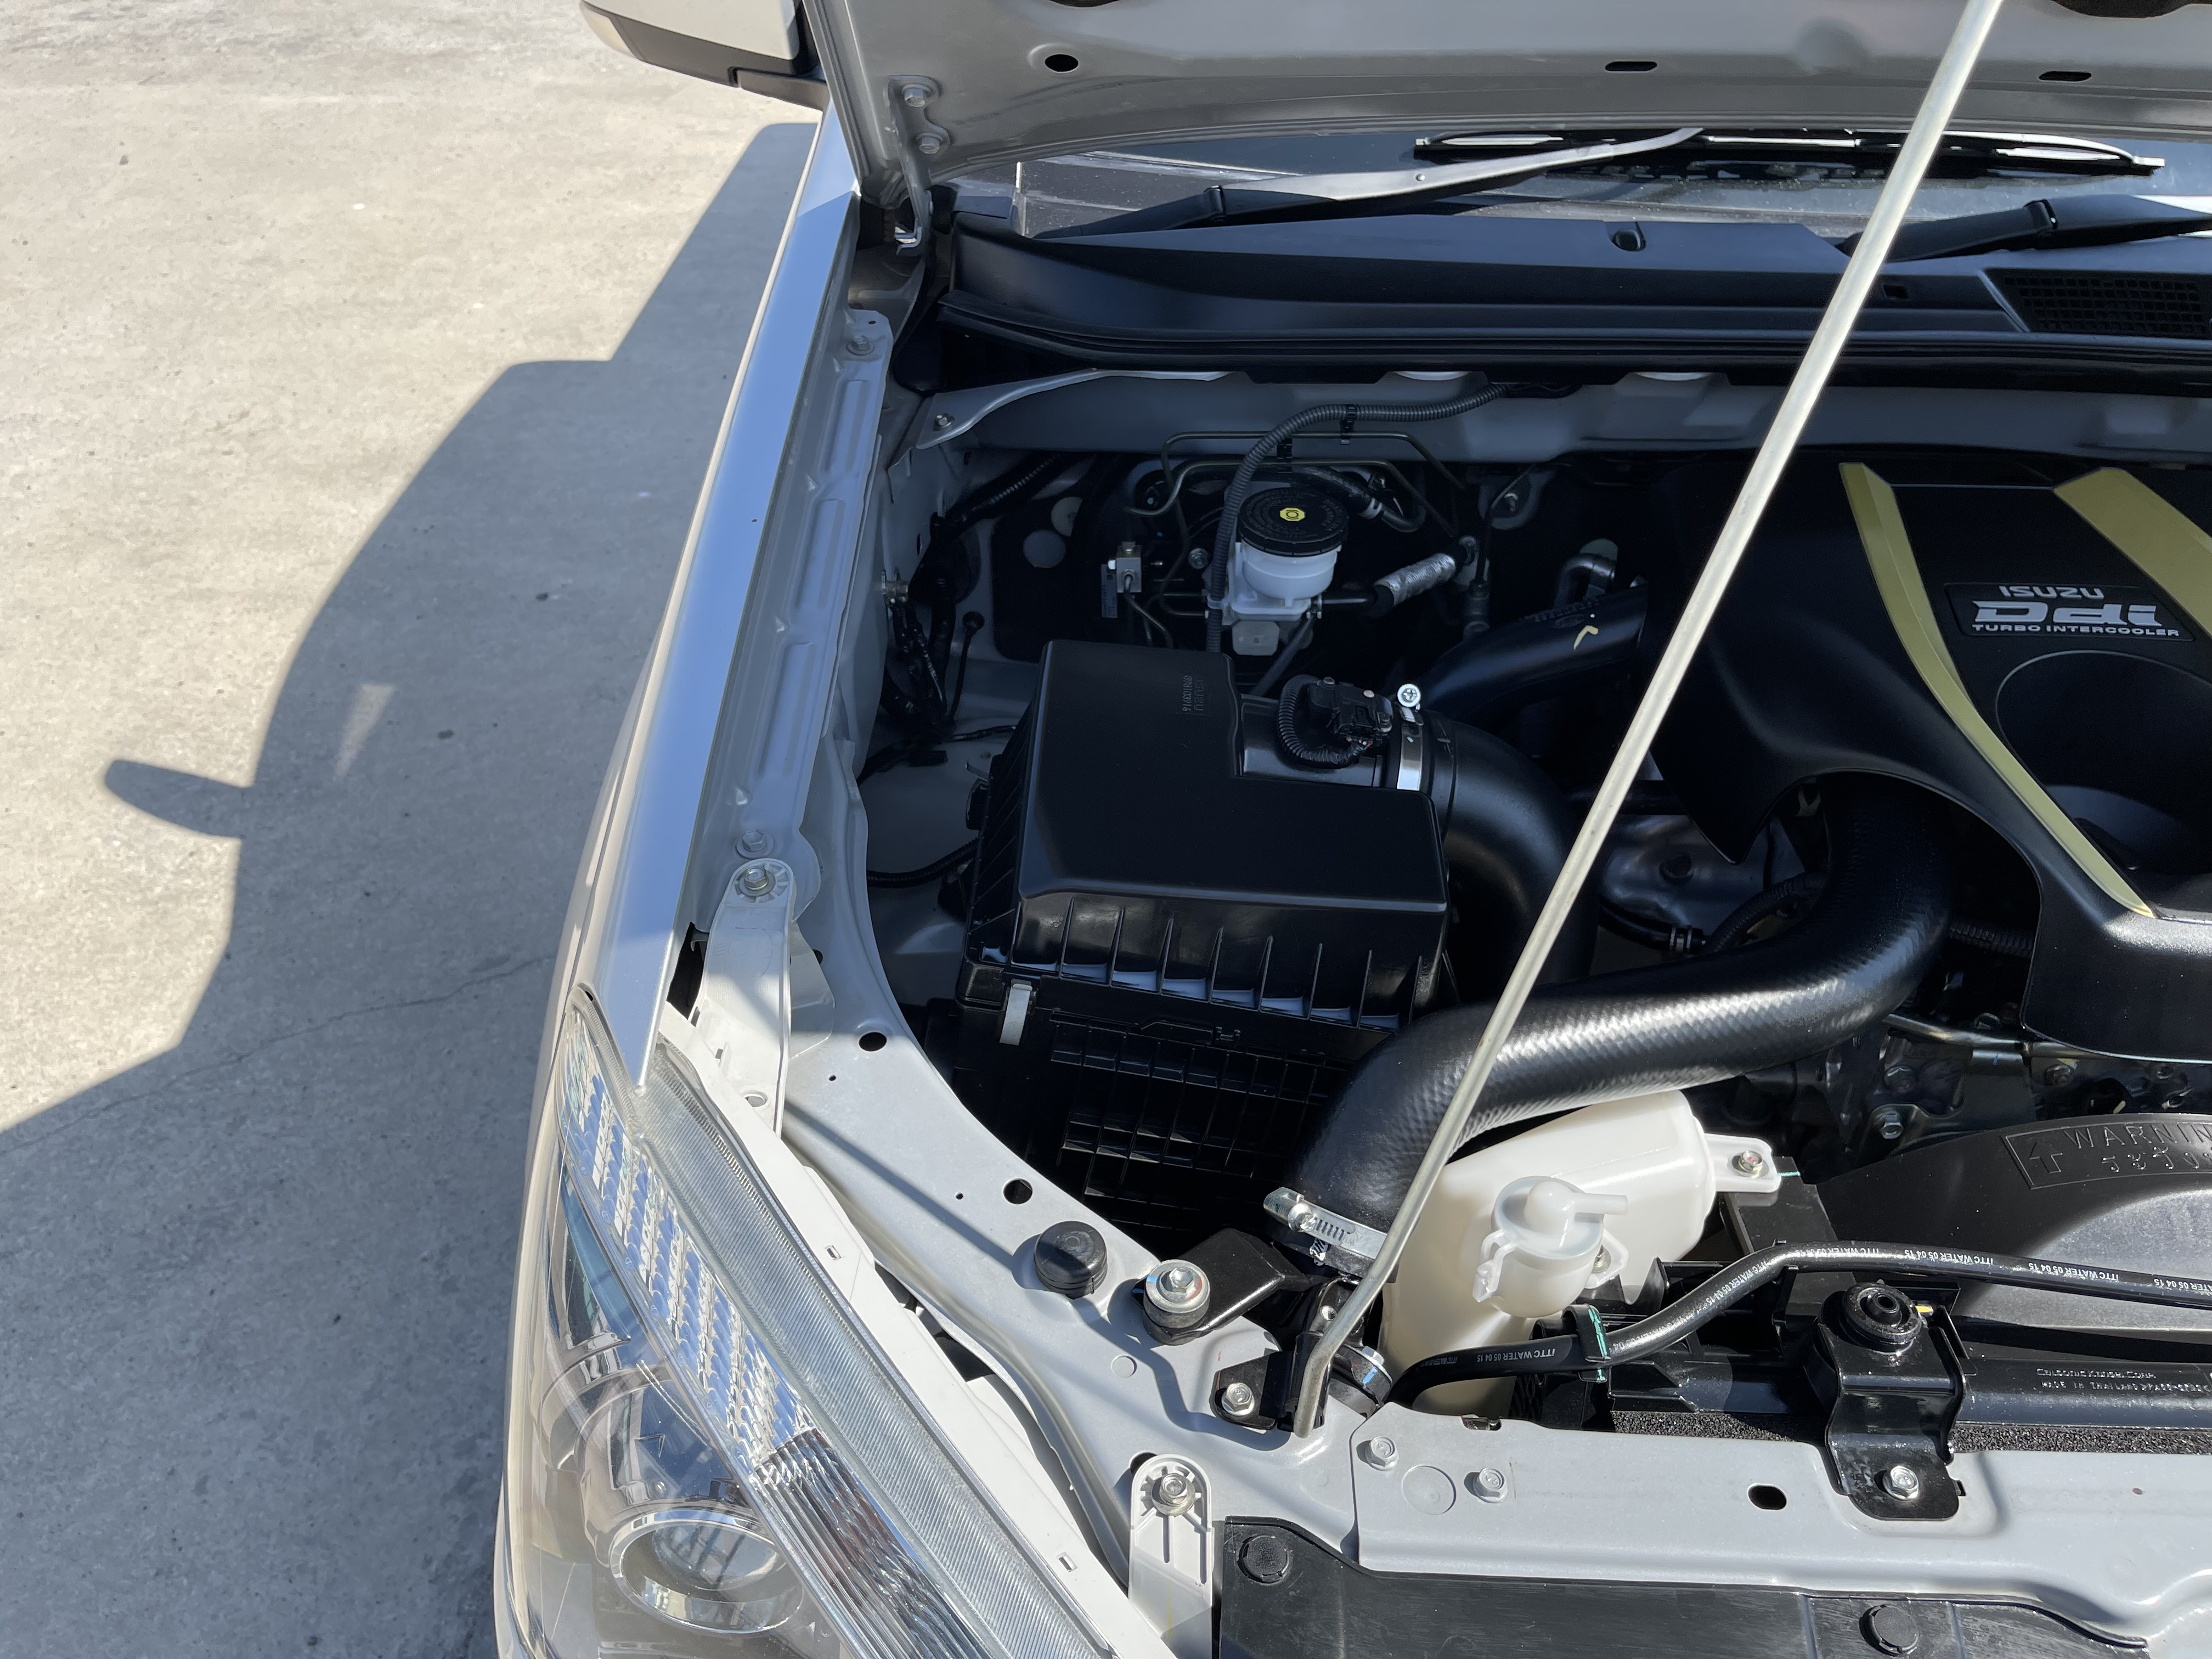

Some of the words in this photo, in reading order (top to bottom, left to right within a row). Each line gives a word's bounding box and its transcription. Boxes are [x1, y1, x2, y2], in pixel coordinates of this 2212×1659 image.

[1999, 585, 2105, 600] ISUZU
[1972, 624, 2041, 632] TURBO
[2046, 625, 2180, 637] INTERCOOLER
[1904, 1249, 1915, 1259] 15
[1916, 1250, 1927, 1260] 04
[1928, 1251, 1939, 1261] 05
[1940, 1252, 1974, 1265] WATER
[2040, 1264, 2051, 1272] 04
[2052, 1266, 2063, 1274] 05
[2064, 1267, 2098, 1279] WATER
[1729, 1269, 1754, 1289] WATER
[2153, 1278, 2165, 1286] 15
[1721, 1284, 1731, 1295] 05
[1477, 1354, 1483, 1363] 15
[1485, 1353, 1492, 1362] 04
[1493, 1353, 1502, 1361] 05
[1503, 1351, 1532, 1361] WATER
